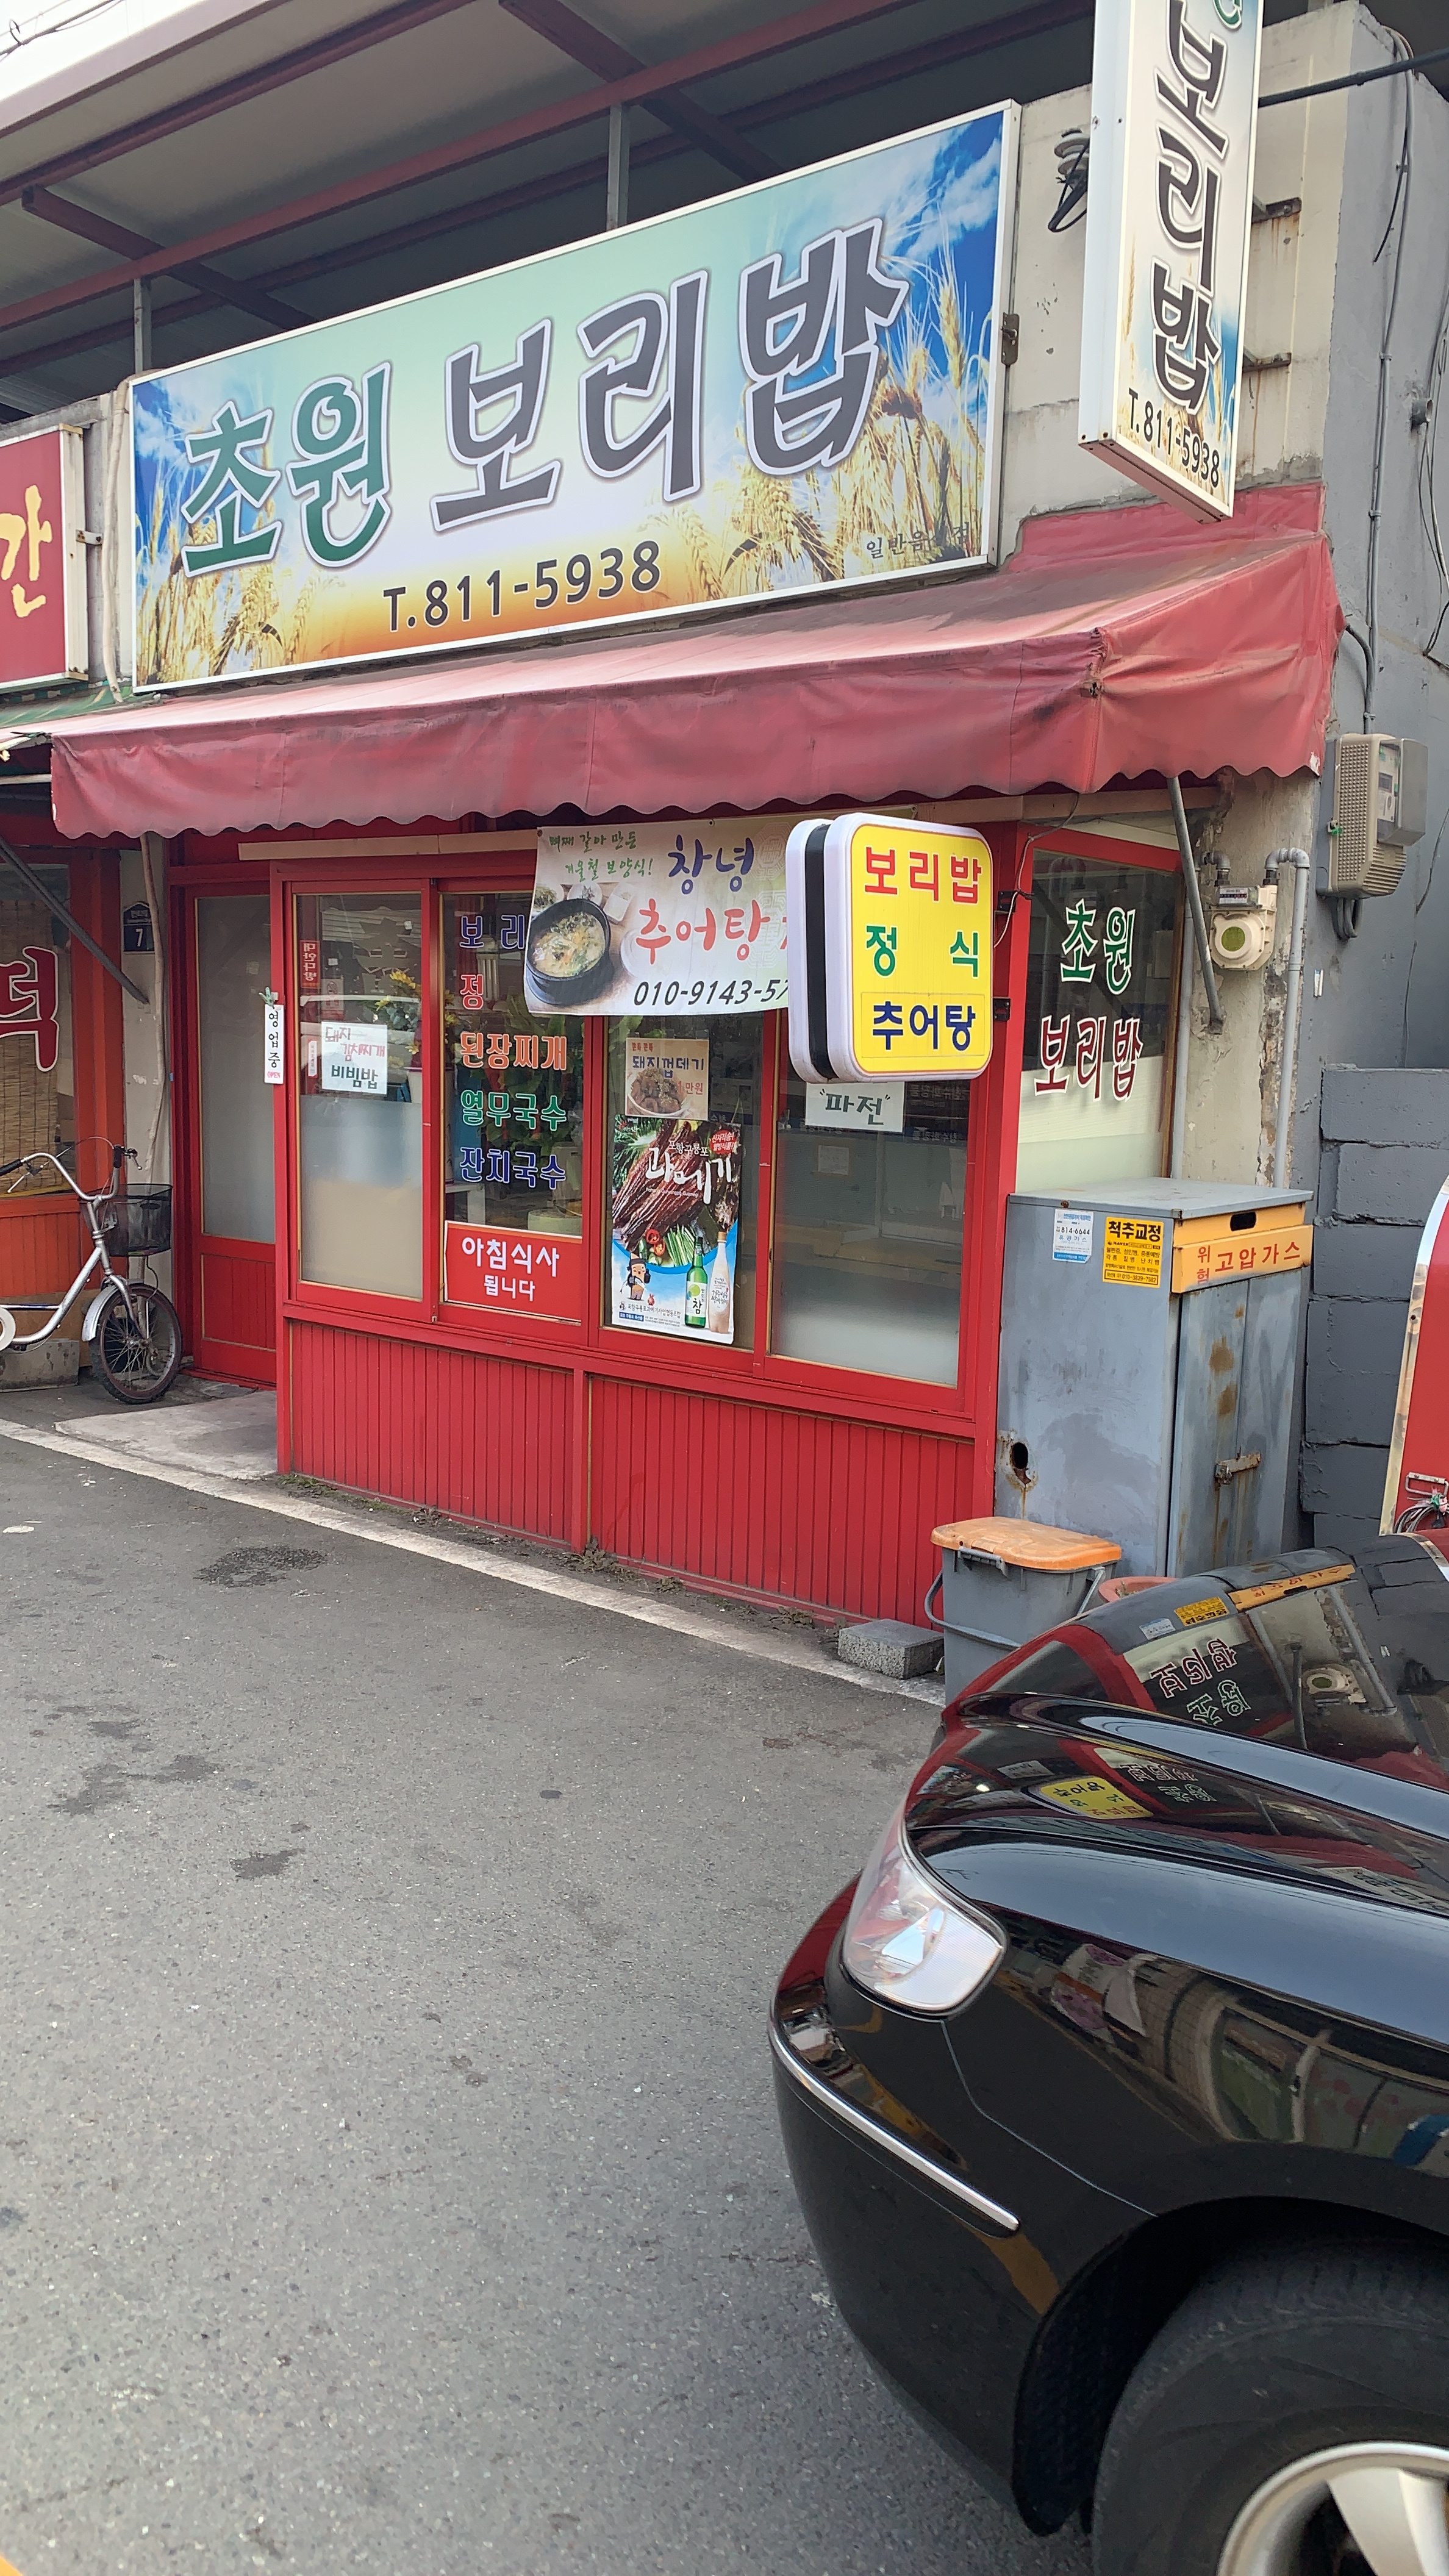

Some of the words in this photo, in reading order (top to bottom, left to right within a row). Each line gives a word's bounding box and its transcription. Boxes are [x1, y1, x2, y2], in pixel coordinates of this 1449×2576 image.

[181, 362, 392, 578] 초원
[429, 217, 911, 533] 보리밥
[1128, 387, 1220, 489] T.811-5938
[867, 521, 970, 559] 일반음점
[382, 539, 662, 632] T.811-5938
[612, 831, 636, 850] 만든
[565, 858, 598, 882] 겨울철
[607, 857, 653, 878] 보양식!
[668, 834, 754, 895] 창녕
[864, 846, 982, 904] 보리밥
[135, 928, 143, 947] 7
[635, 898, 771, 965] 추어탕
[1061, 898, 1136, 995] 초원
[872, 1000, 976, 1051] 추어탕
[460, 1031, 567, 1070] 된장찌개
[632, 1056, 704, 1078] 돼지껍데기
[1034, 1014, 1143, 1103] 보리밥
[331, 1065, 378, 1090] 비빔밥
[460, 1090, 567, 1131] 열무국수
[460, 1147, 566, 1190] 잔치국수
[646, 1147, 732, 1205] 과메기
[1109, 1221, 1161, 1242] 척추교정
[462, 1237, 559, 1277] 아침식사
[1215, 1241, 1301, 1273] 고압가스
[484, 1274, 535, 1301] 됩니다
[692, 1298, 703, 1314] 참
